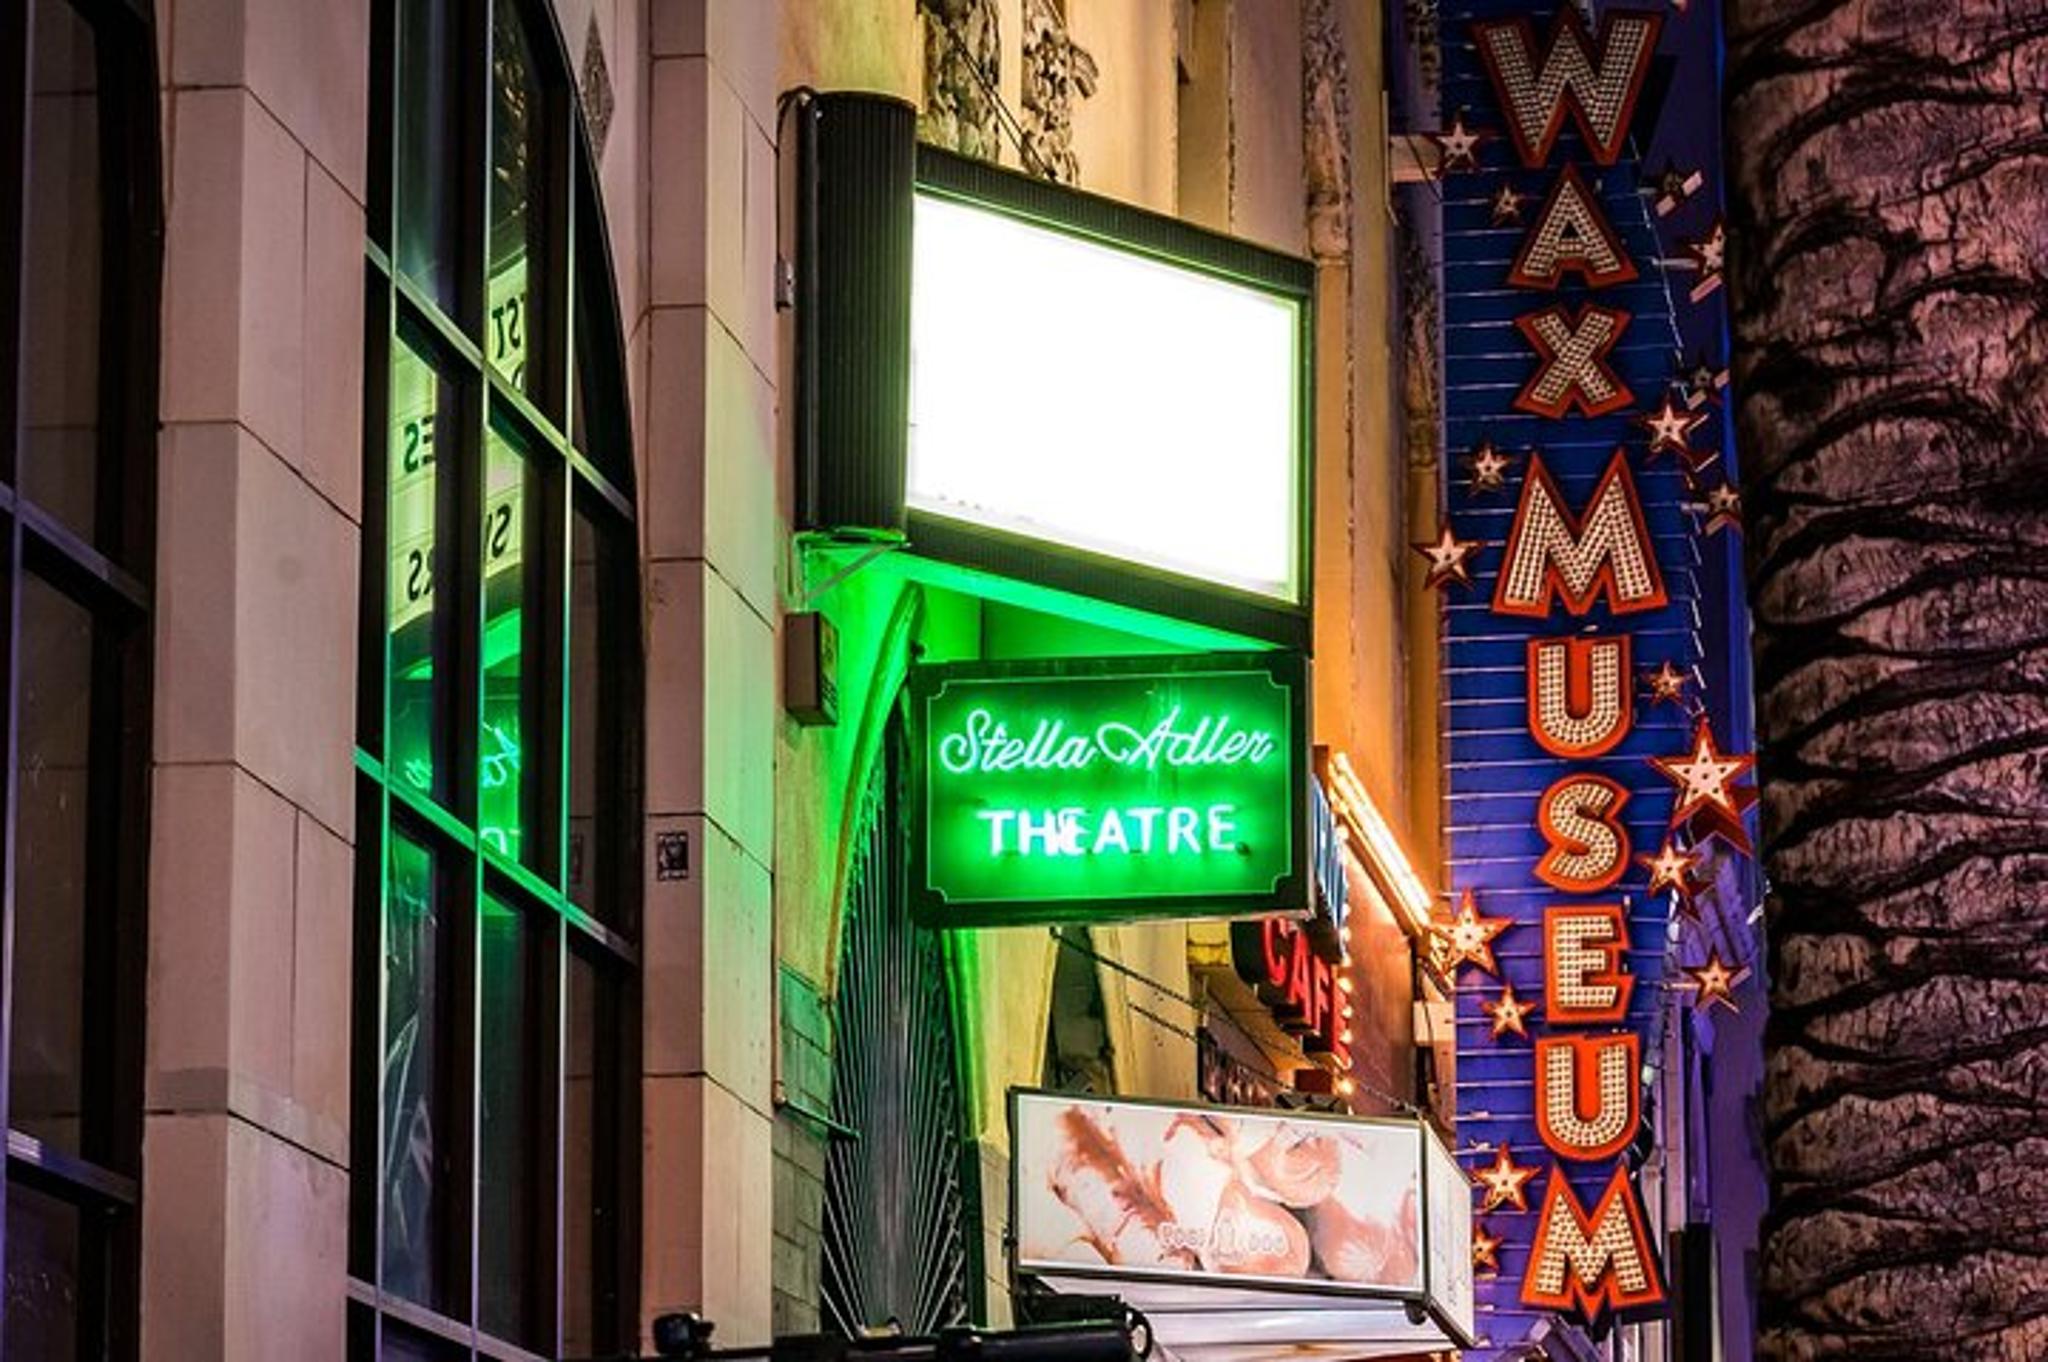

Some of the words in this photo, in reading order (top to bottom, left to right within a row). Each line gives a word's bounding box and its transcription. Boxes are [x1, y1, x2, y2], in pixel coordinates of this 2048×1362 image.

[1471, 6, 1665, 419] WAX
[940, 709, 1099, 773] Stella
[1097, 705, 1273, 770] Adler
[977, 804, 1236, 858] THEATRE
[1491, 447, 1669, 1323] MUSEUM
